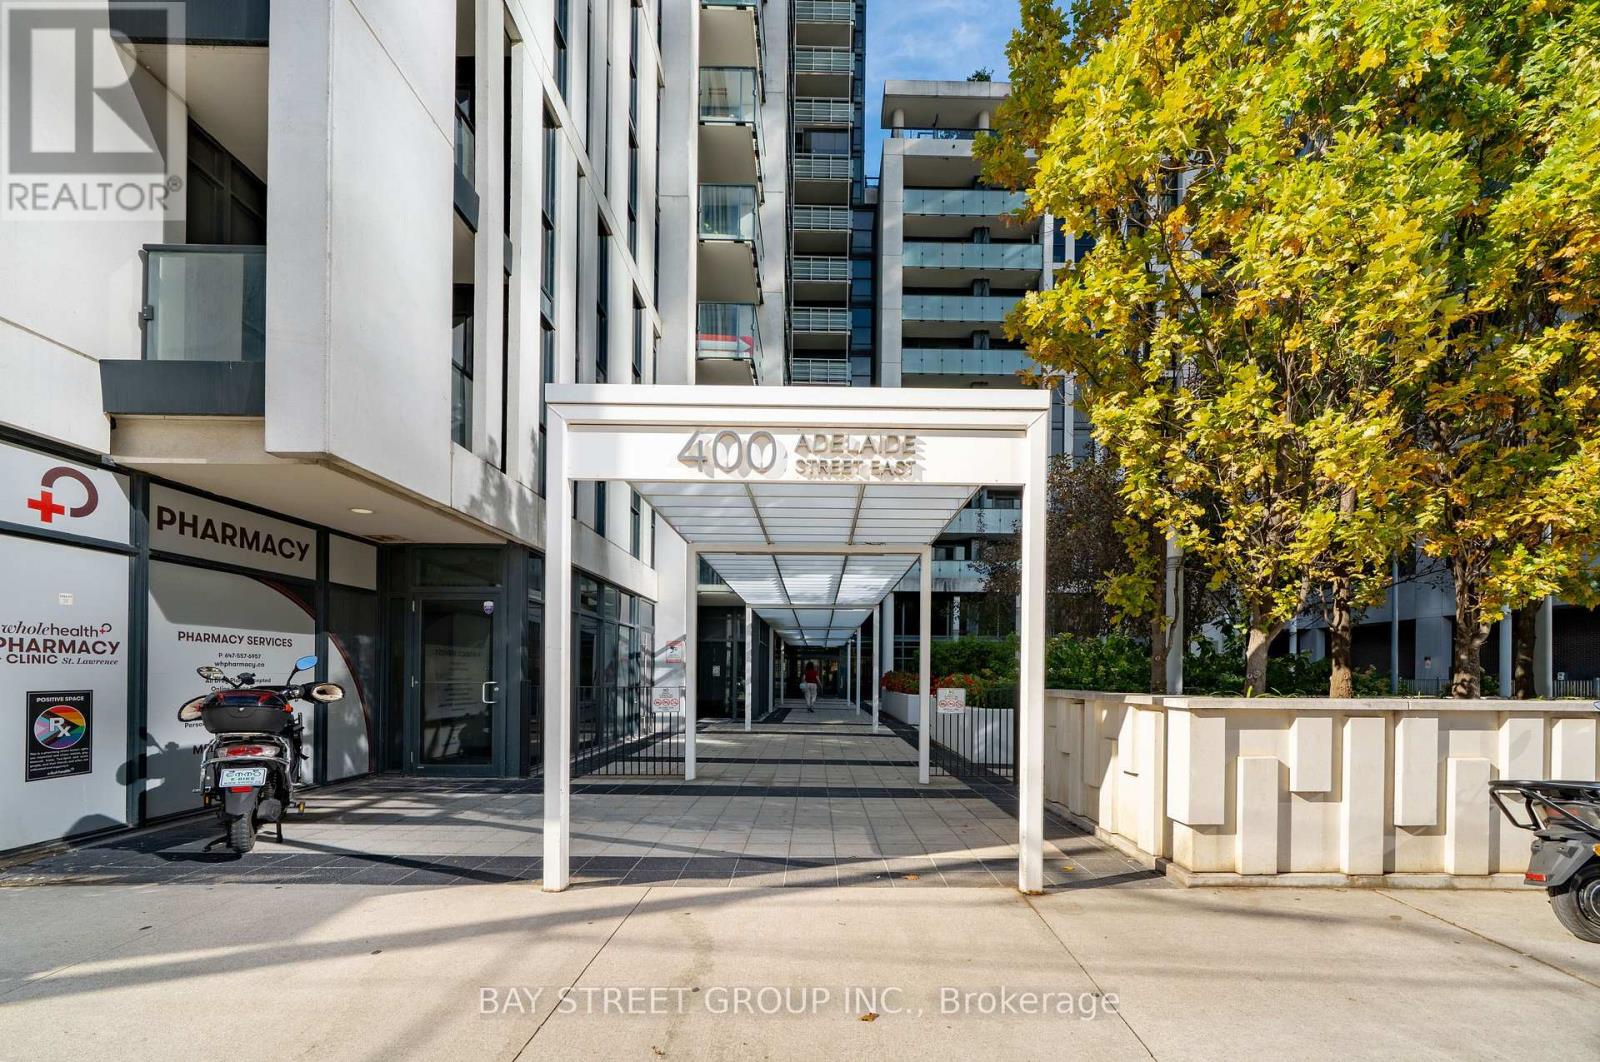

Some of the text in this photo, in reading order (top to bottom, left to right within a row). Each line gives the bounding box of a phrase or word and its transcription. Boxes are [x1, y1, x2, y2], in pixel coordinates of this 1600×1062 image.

[677, 430, 777, 475] 400
[795, 434, 917, 455] ADELAIDE
[795, 460, 916, 476] STREET EAST
[157, 505, 310, 561] PHARMACY
[178, 631, 293, 647] PHARMACY SERVICES
[6, 653, 58, 664] CLINIC
